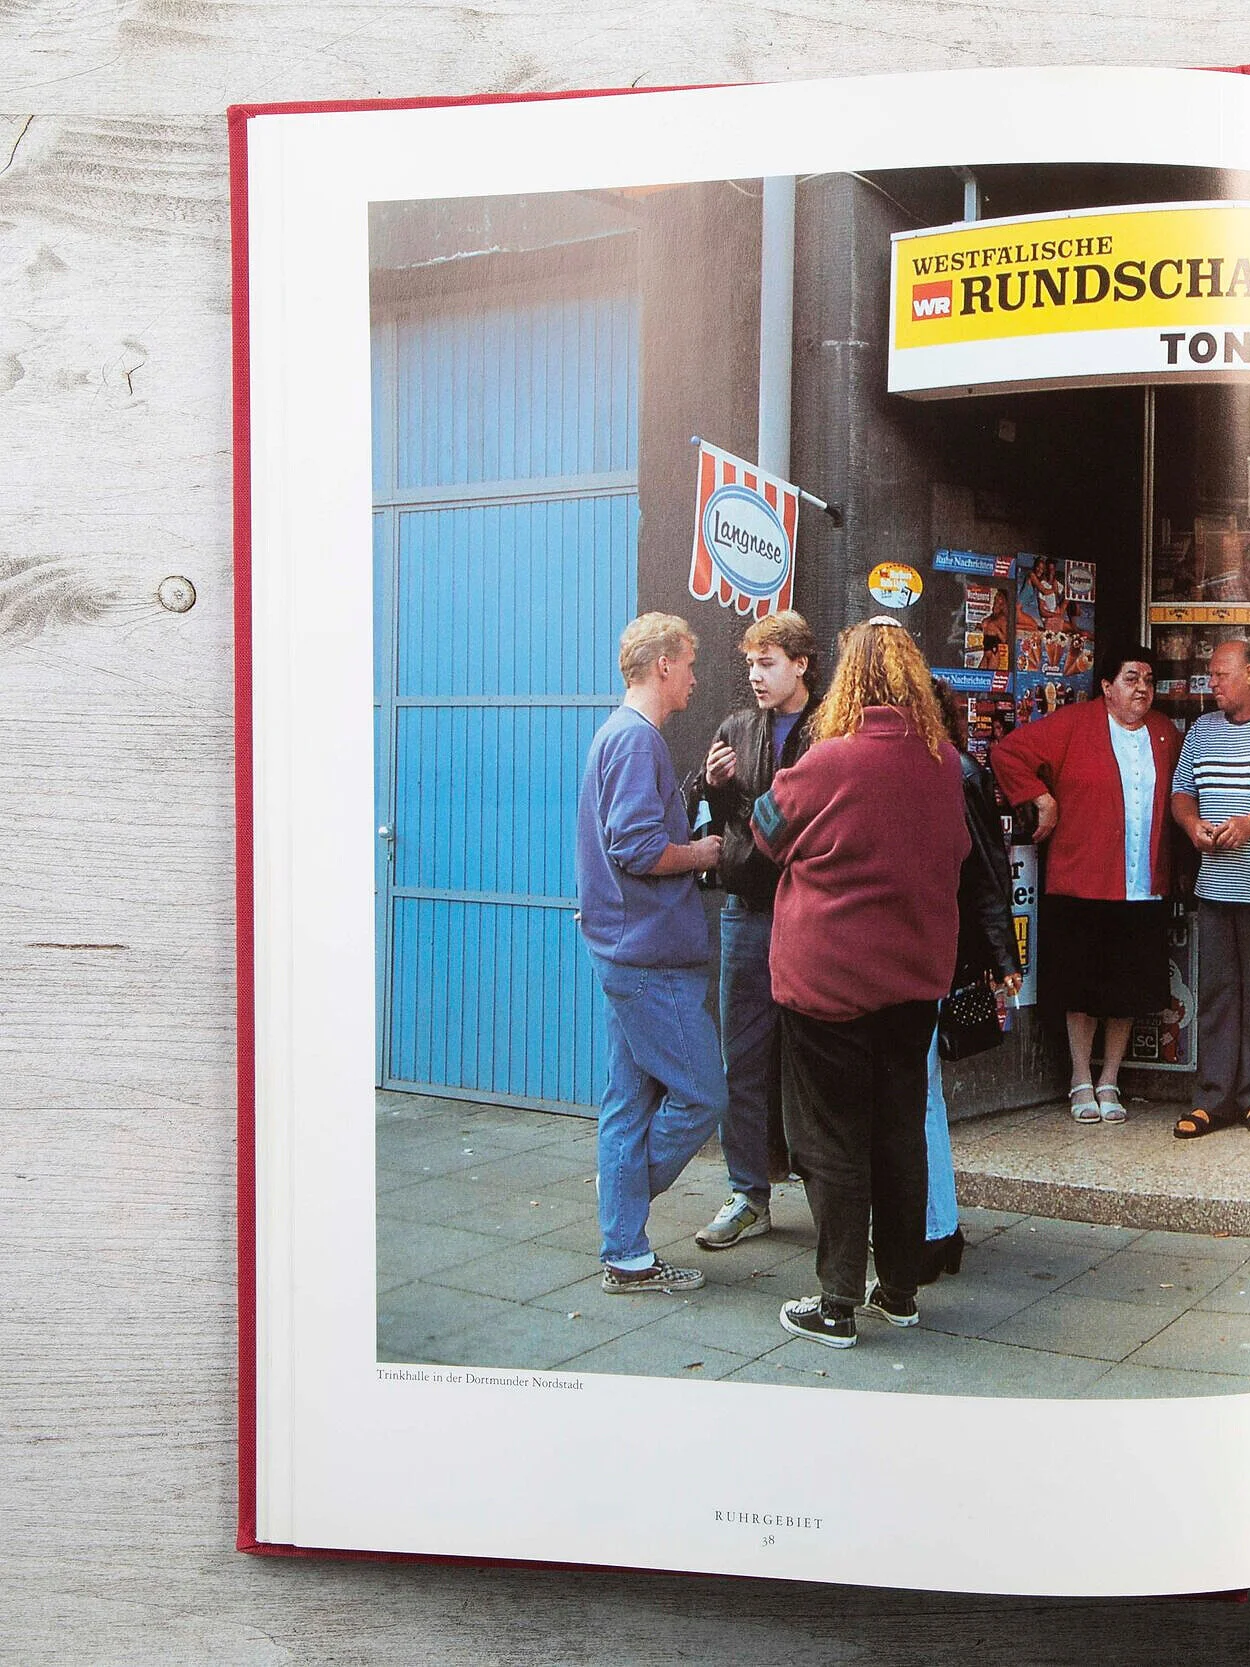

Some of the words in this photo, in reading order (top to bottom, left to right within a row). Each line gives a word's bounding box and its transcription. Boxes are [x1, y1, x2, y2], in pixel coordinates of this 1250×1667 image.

[912, 236, 1113, 276] WESTFÄLISCHE
[913, 296, 952, 318] WR
[714, 510, 783, 564] Langnese
[376, 1369, 430, 1382] Trinkhalle
[433, 1372, 443, 1382] in
[446, 1373, 462, 1384] der
[466, 1373, 529, 1387] Dortmunder
[532, 1376, 584, 1390] Nordstadt
[715, 1510, 823, 1529] RUHRGEBIET
[762, 1534, 775, 1548] 38
